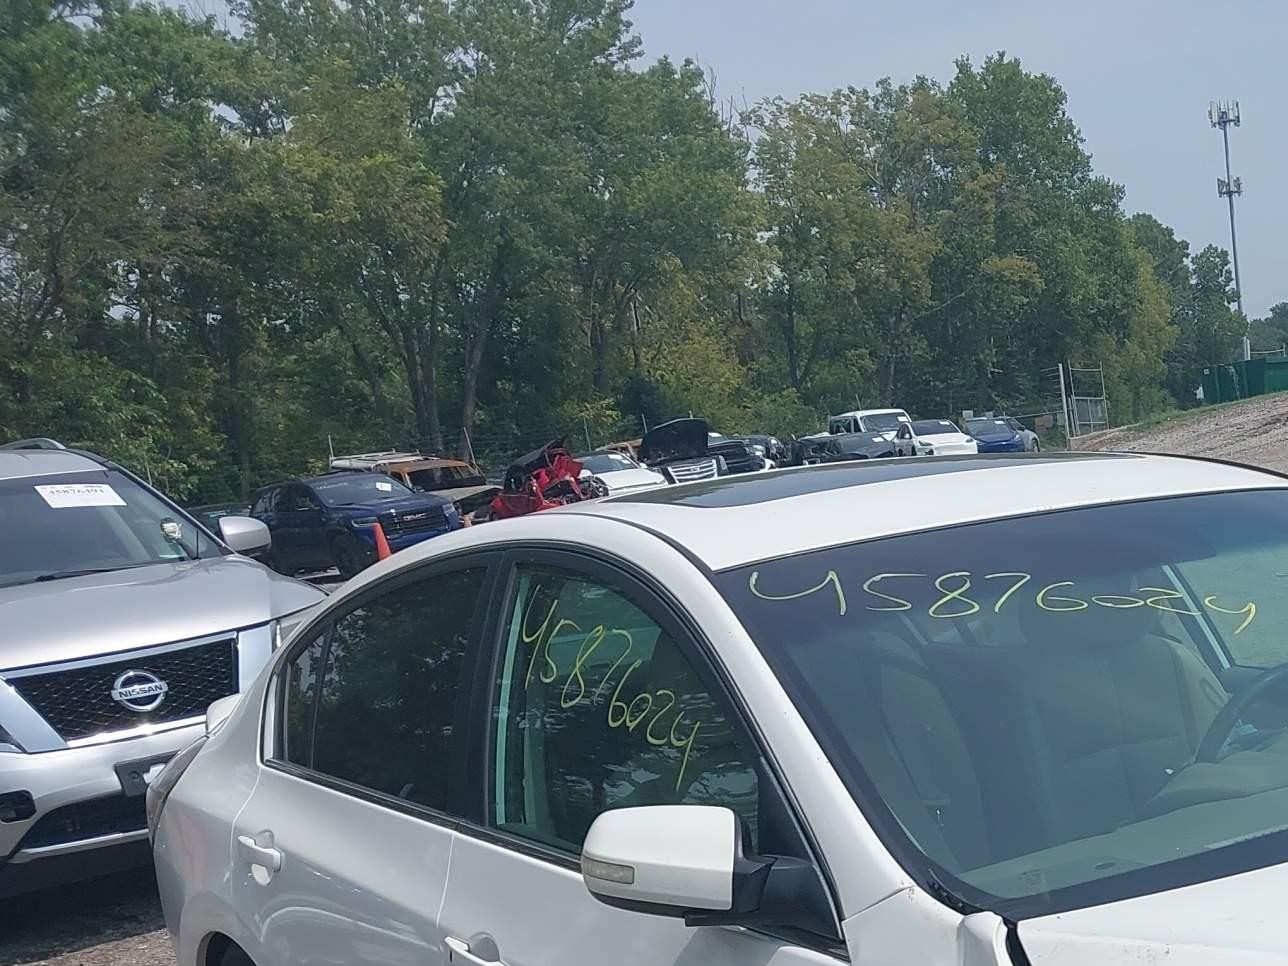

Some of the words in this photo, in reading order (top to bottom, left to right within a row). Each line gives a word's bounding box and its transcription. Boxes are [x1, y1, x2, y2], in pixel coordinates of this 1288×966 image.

[749, 571, 1256, 634] 45876024
[118, 683, 163, 698] NISSAN
[522, 584, 700, 792] 45876024
